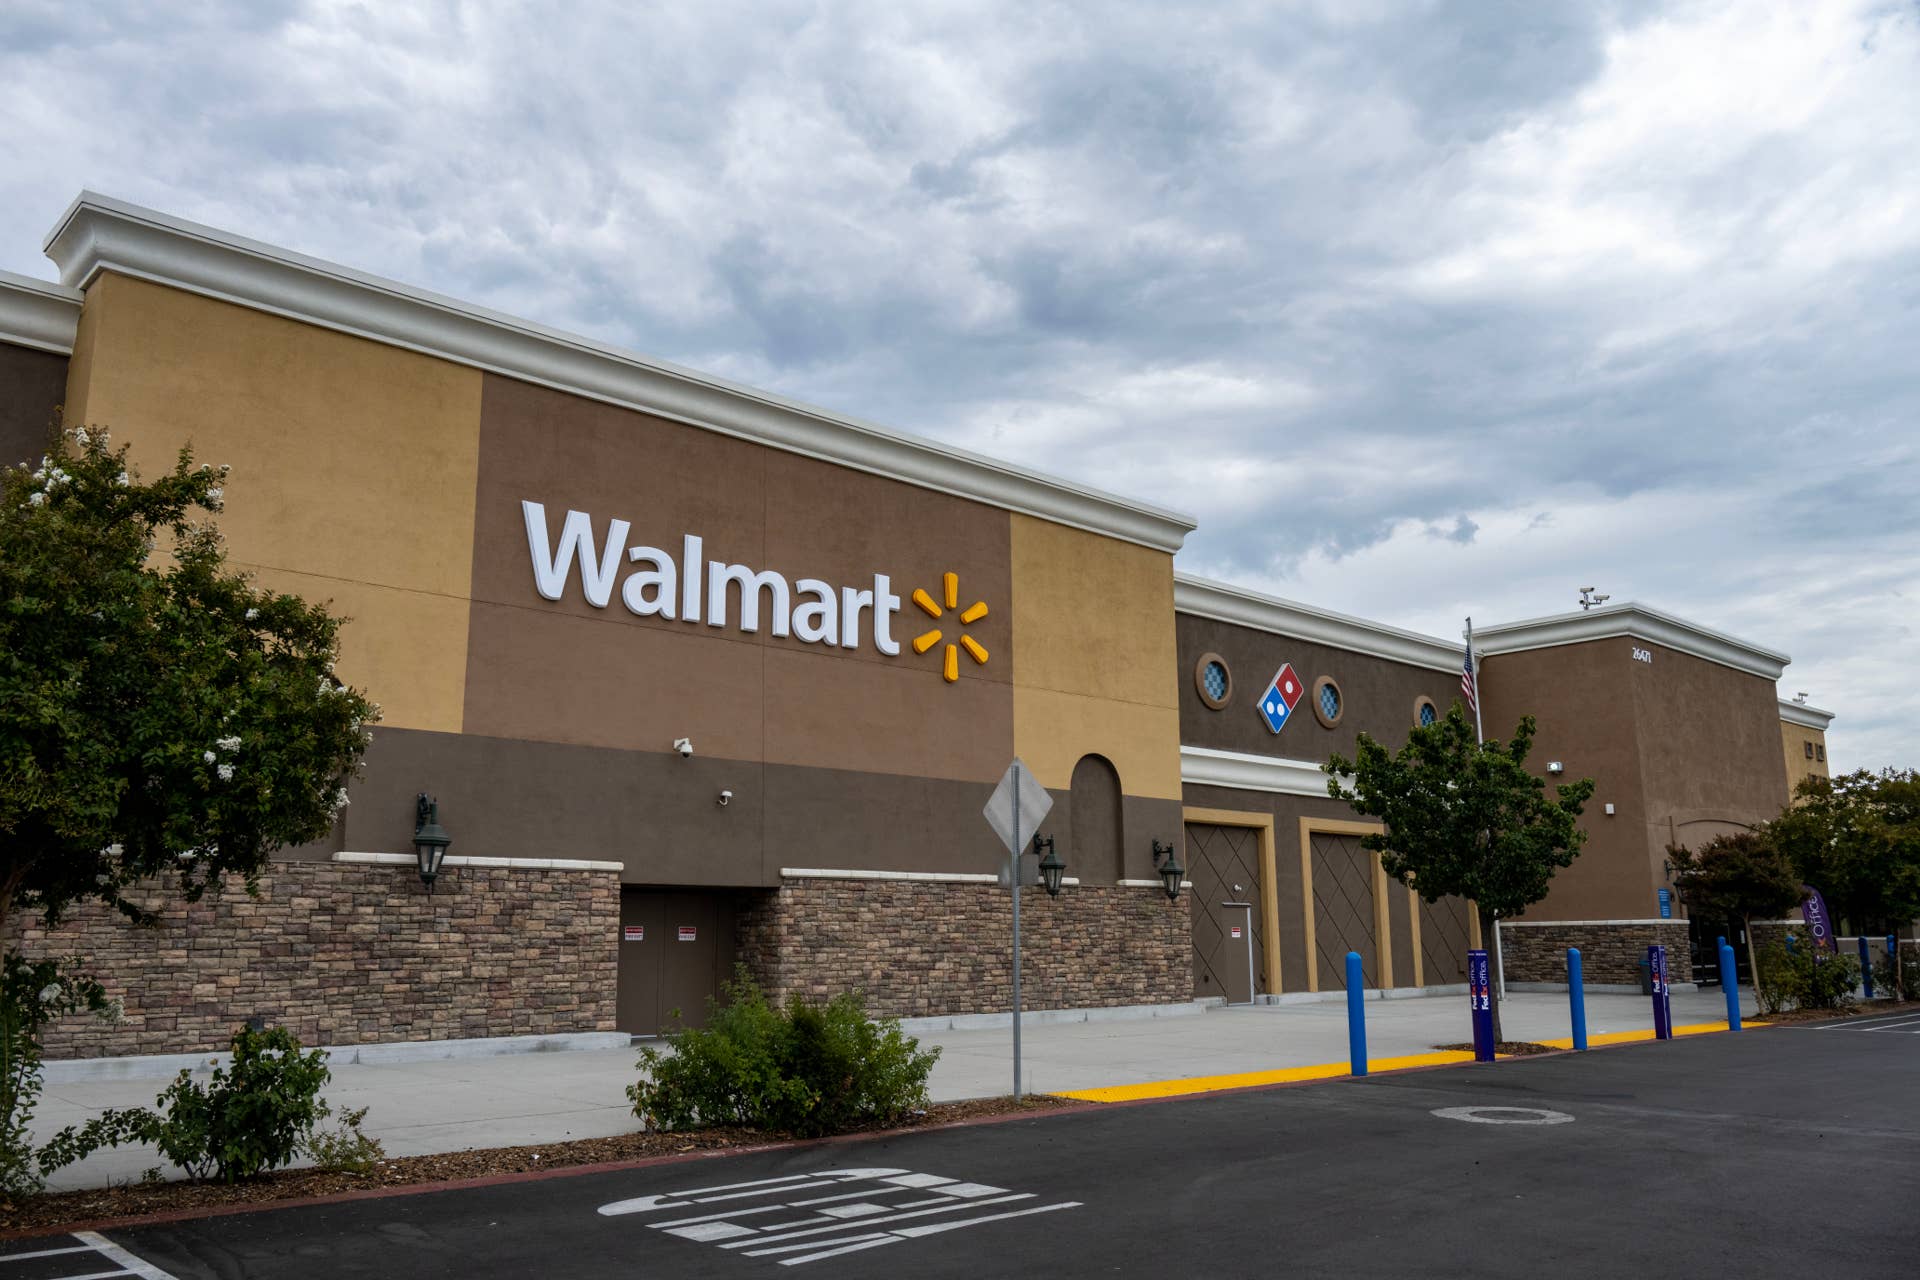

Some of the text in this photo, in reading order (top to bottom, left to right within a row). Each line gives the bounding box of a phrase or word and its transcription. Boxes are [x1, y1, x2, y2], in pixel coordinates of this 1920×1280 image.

[521, 500, 900, 656] Walmart
[1809, 895, 1825, 937] Office
[1481, 985, 1489, 1010] FedEx
[597, 1168, 1085, 1266] YIELD
